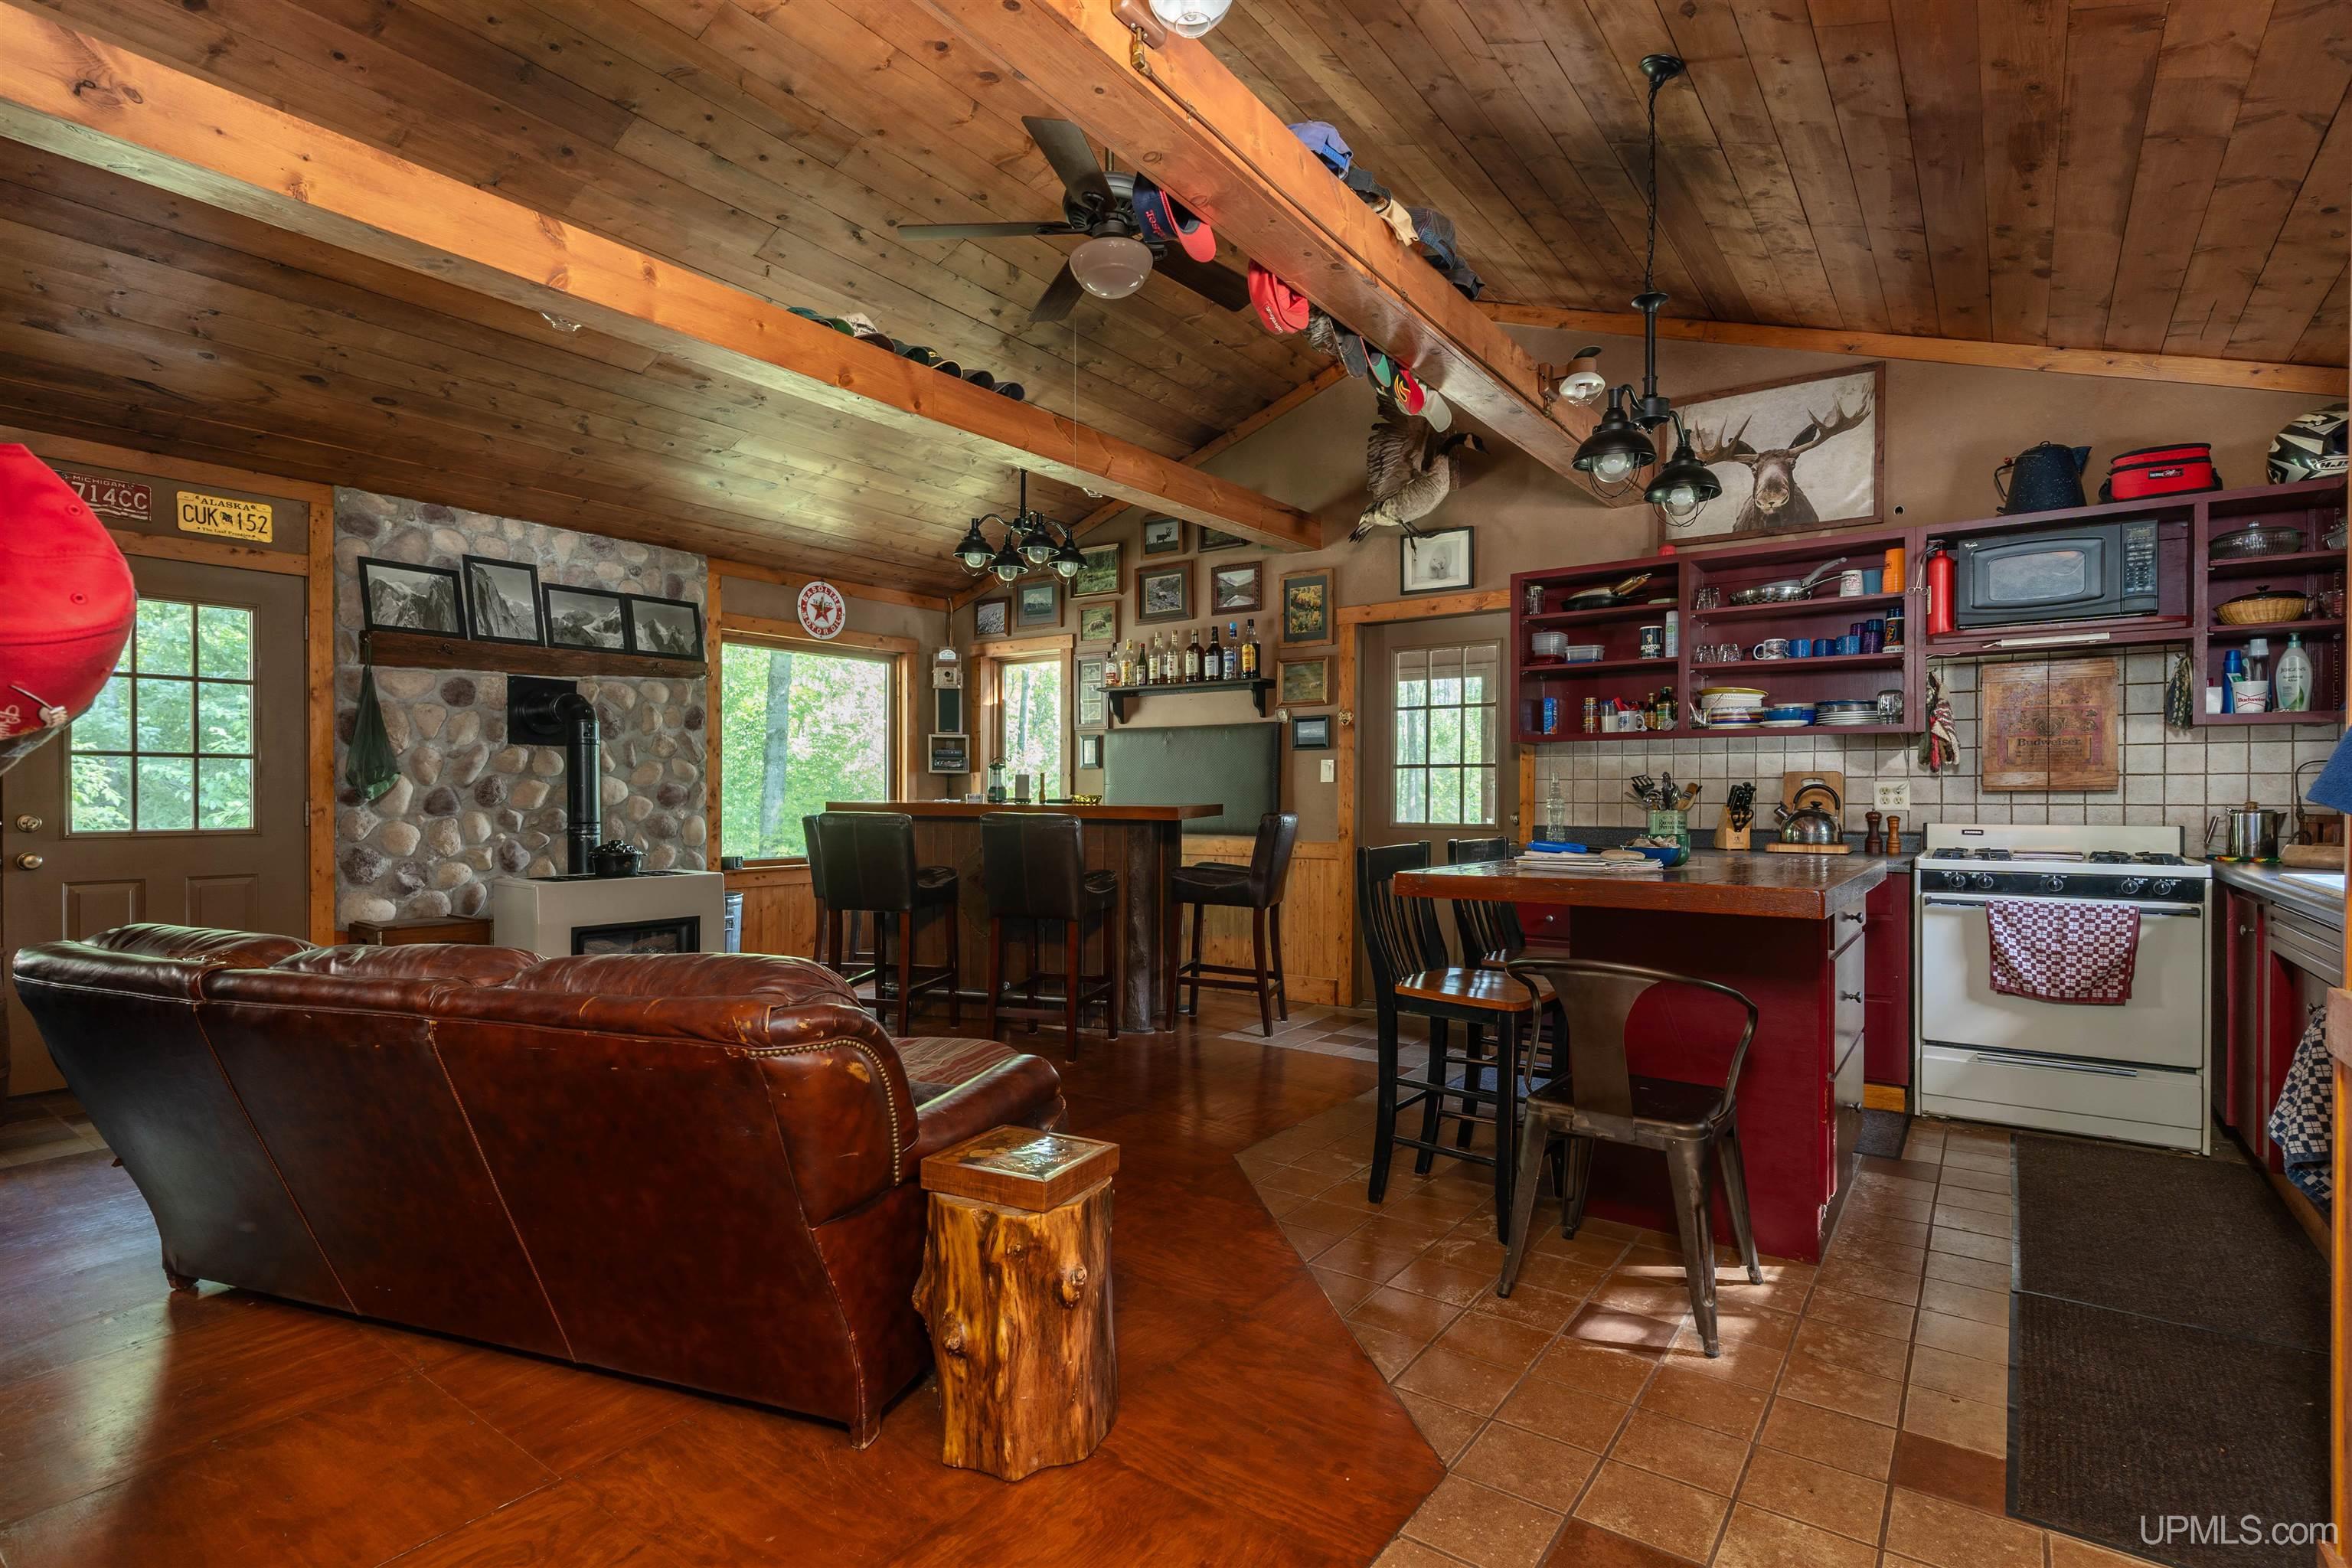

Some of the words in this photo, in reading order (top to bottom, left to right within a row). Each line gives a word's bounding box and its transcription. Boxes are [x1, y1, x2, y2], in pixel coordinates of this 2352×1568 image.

[72, 475, 126, 489] MICHIGAN
[201, 498, 250, 511] ALASKA
[183, 504, 218, 527] CUK
[237, 511, 268, 534] 152
[802, 586, 841, 609] GASOLINE
[802, 612, 828, 635] MOTOR
[830, 619, 841, 632] OIL
